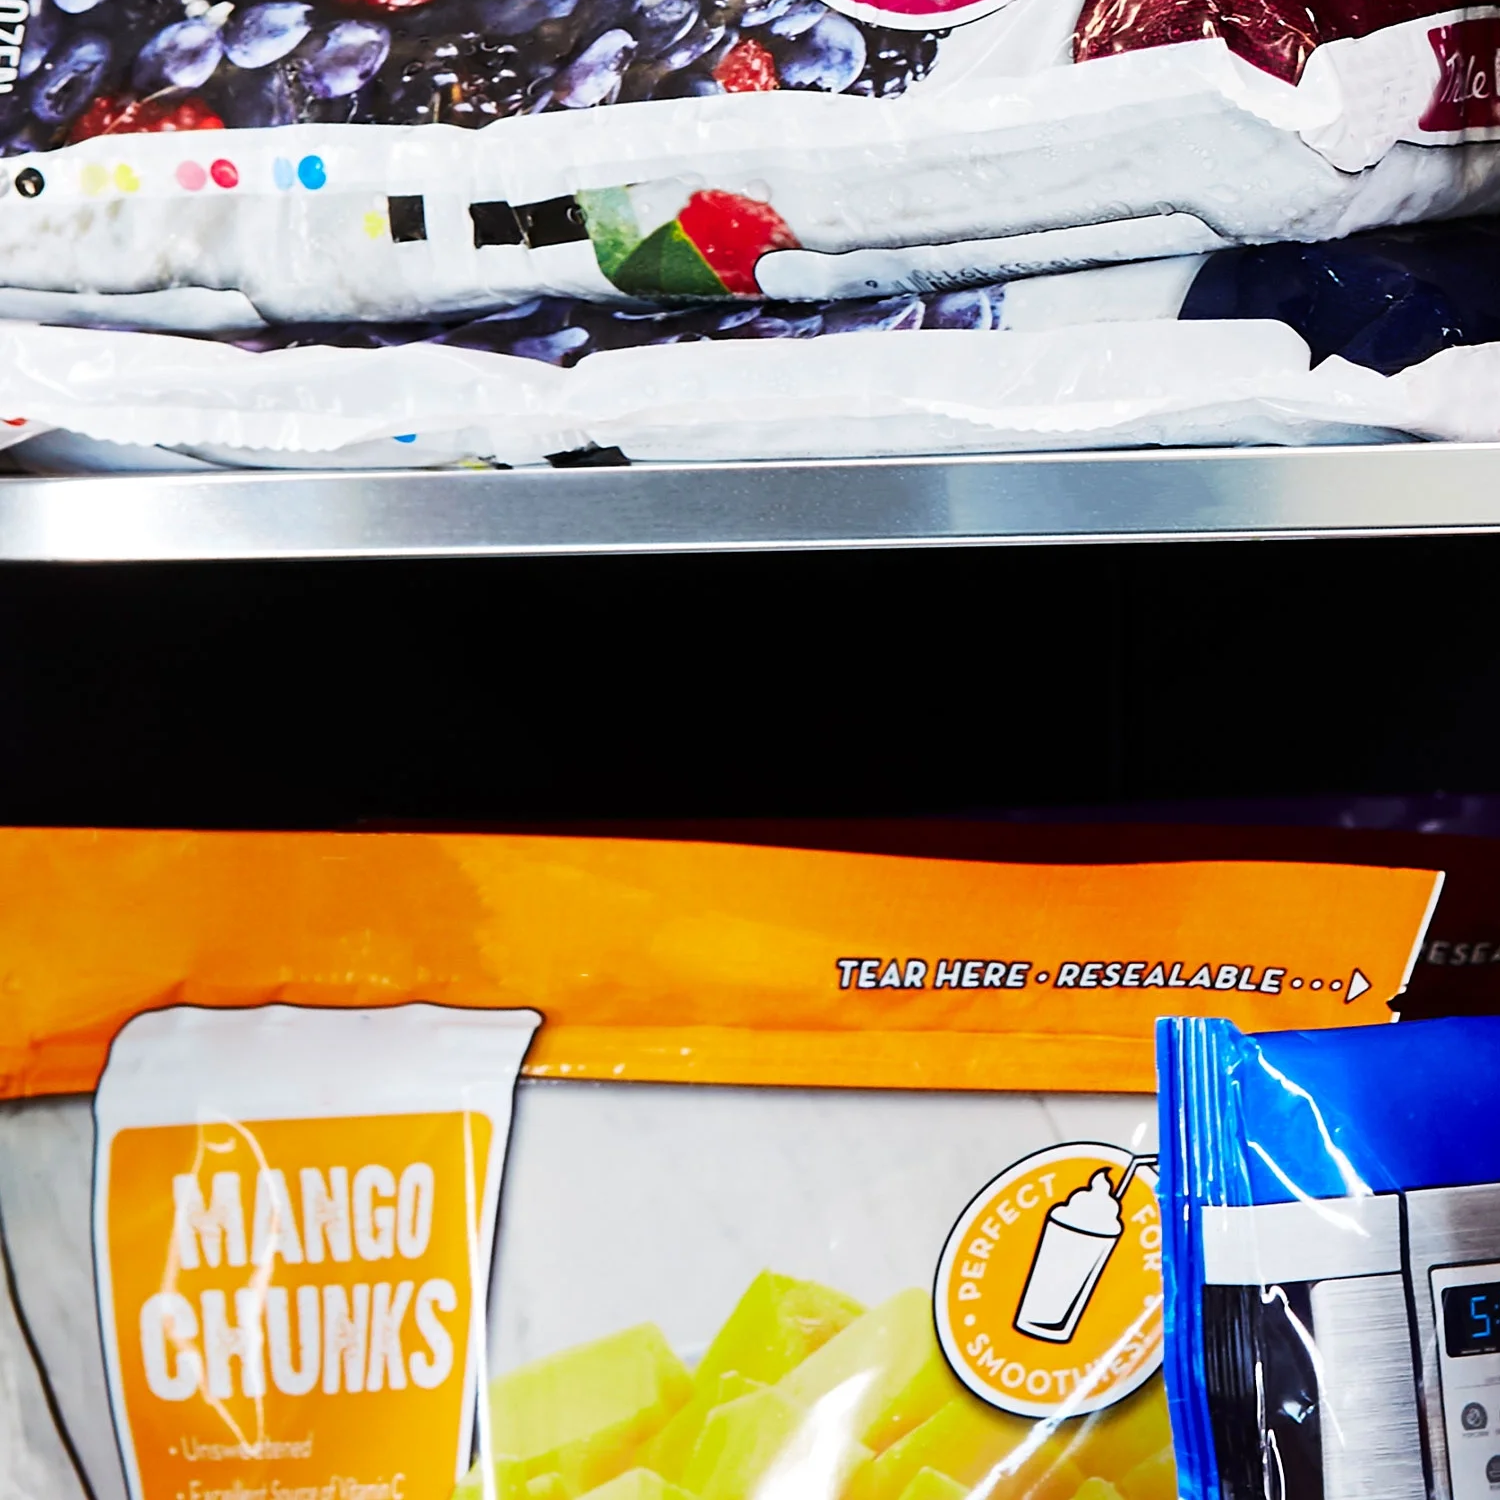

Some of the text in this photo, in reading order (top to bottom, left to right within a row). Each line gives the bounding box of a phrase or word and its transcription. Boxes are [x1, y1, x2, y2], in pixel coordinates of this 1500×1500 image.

[838, 959, 1286, 994] TEAR HERE RESEALABLE
[173, 1162, 434, 1270] MANGO
[958, 1173, 1057, 1301] PERFECT
[140, 1279, 457, 1402] CHUNKS
[181, 1435, 313, 1462] Unswtened
